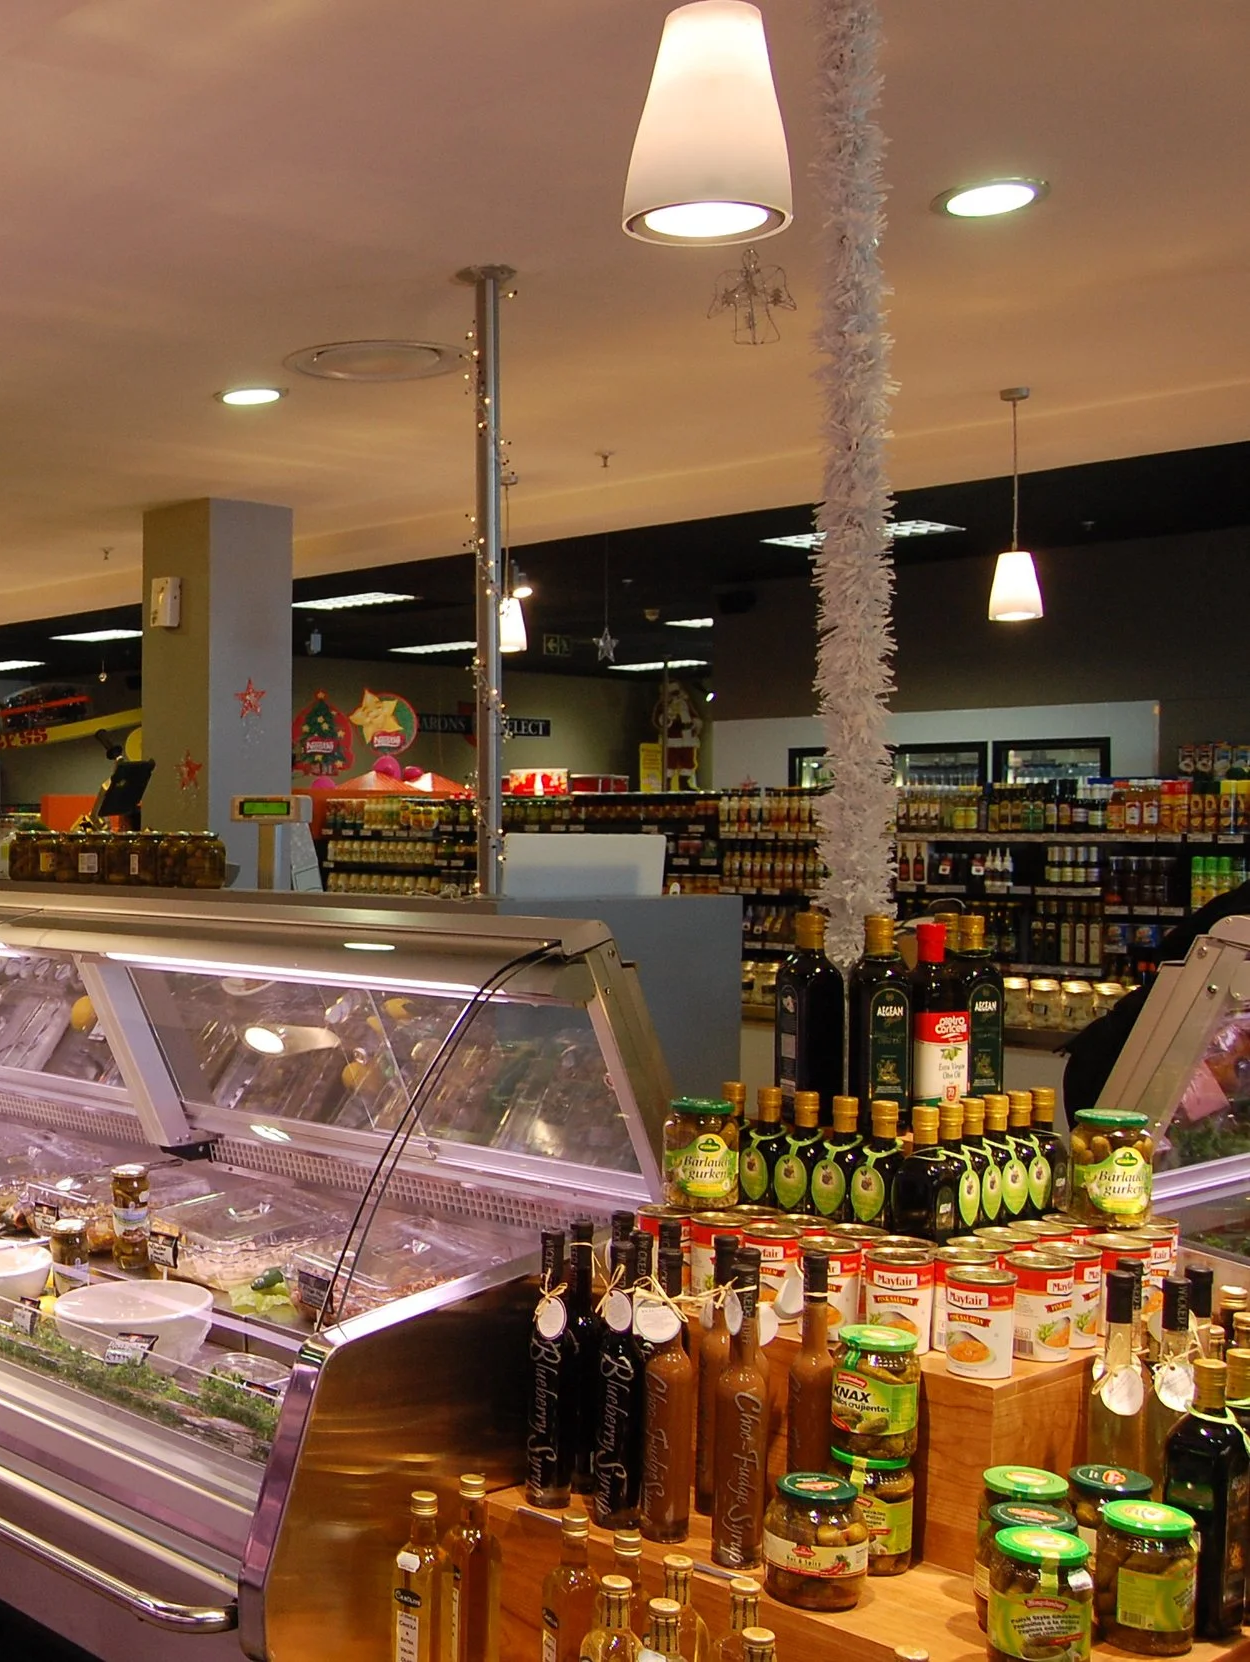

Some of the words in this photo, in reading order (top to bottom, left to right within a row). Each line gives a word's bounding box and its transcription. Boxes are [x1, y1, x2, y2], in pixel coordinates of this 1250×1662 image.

[421, 715, 467, 732] ARONS
[505, 720, 546, 736] ELECT
[877, 1005, 904, 1017] AEGEAN
[974, 1001, 997, 1012] AEGEAN
[545, 1239, 555, 1270] WICKE
[877, 1274, 913, 1288] Mayfair
[949, 1291, 983, 1307] Mayfair
[528, 1337, 562, 1434] Blueberry
[833, 1383, 871, 1403] KNAX
[596, 1352, 635, 1453] Blueberry
[849, 1401, 890, 1413] crujientes
[526, 1434, 558, 1498] Syrup
[594, 1450, 628, 1515] Syrup
[720, 1501, 755, 1563] Syrup
